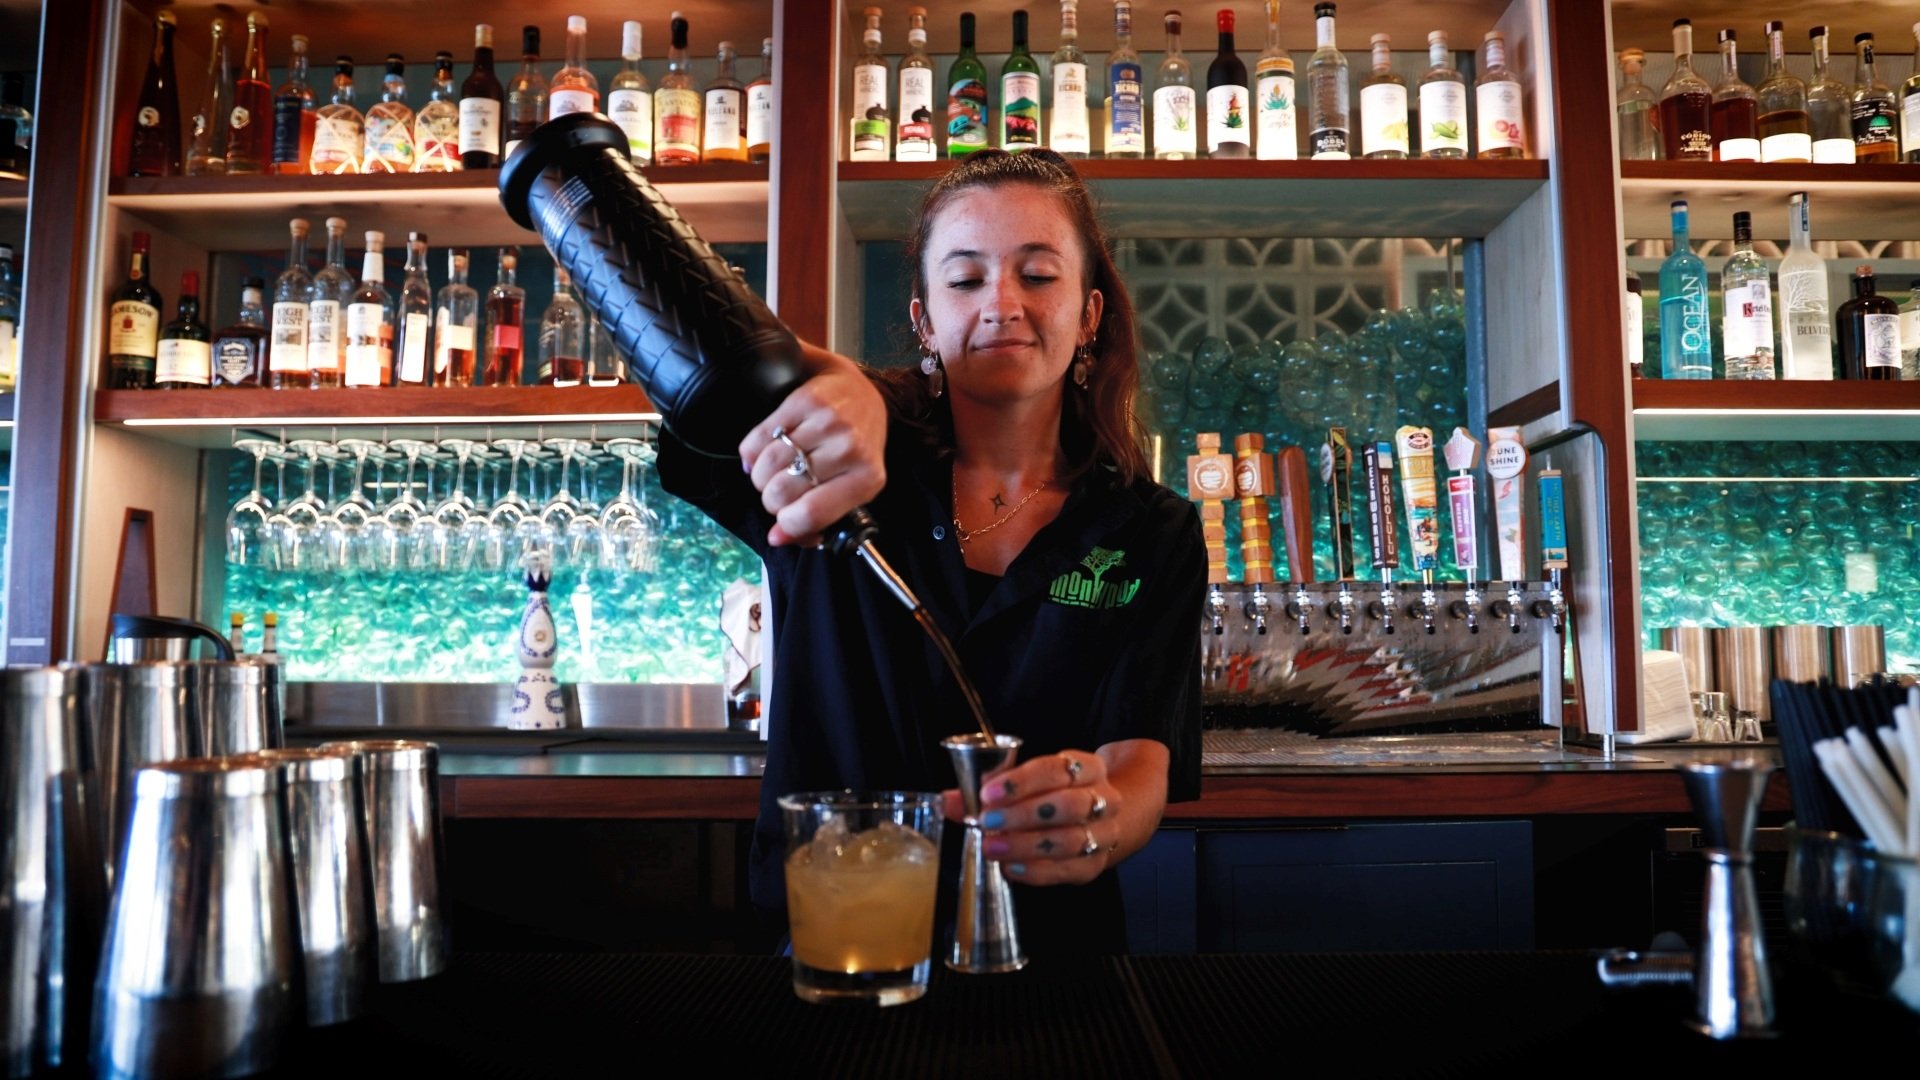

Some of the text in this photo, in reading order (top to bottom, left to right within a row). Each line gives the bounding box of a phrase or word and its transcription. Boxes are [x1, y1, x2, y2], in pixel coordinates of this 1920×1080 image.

[1682, 274, 1703, 351] OCEAN
[1490, 456, 1519, 466] SHINE
[1382, 474, 1395, 555] HONOLULU
